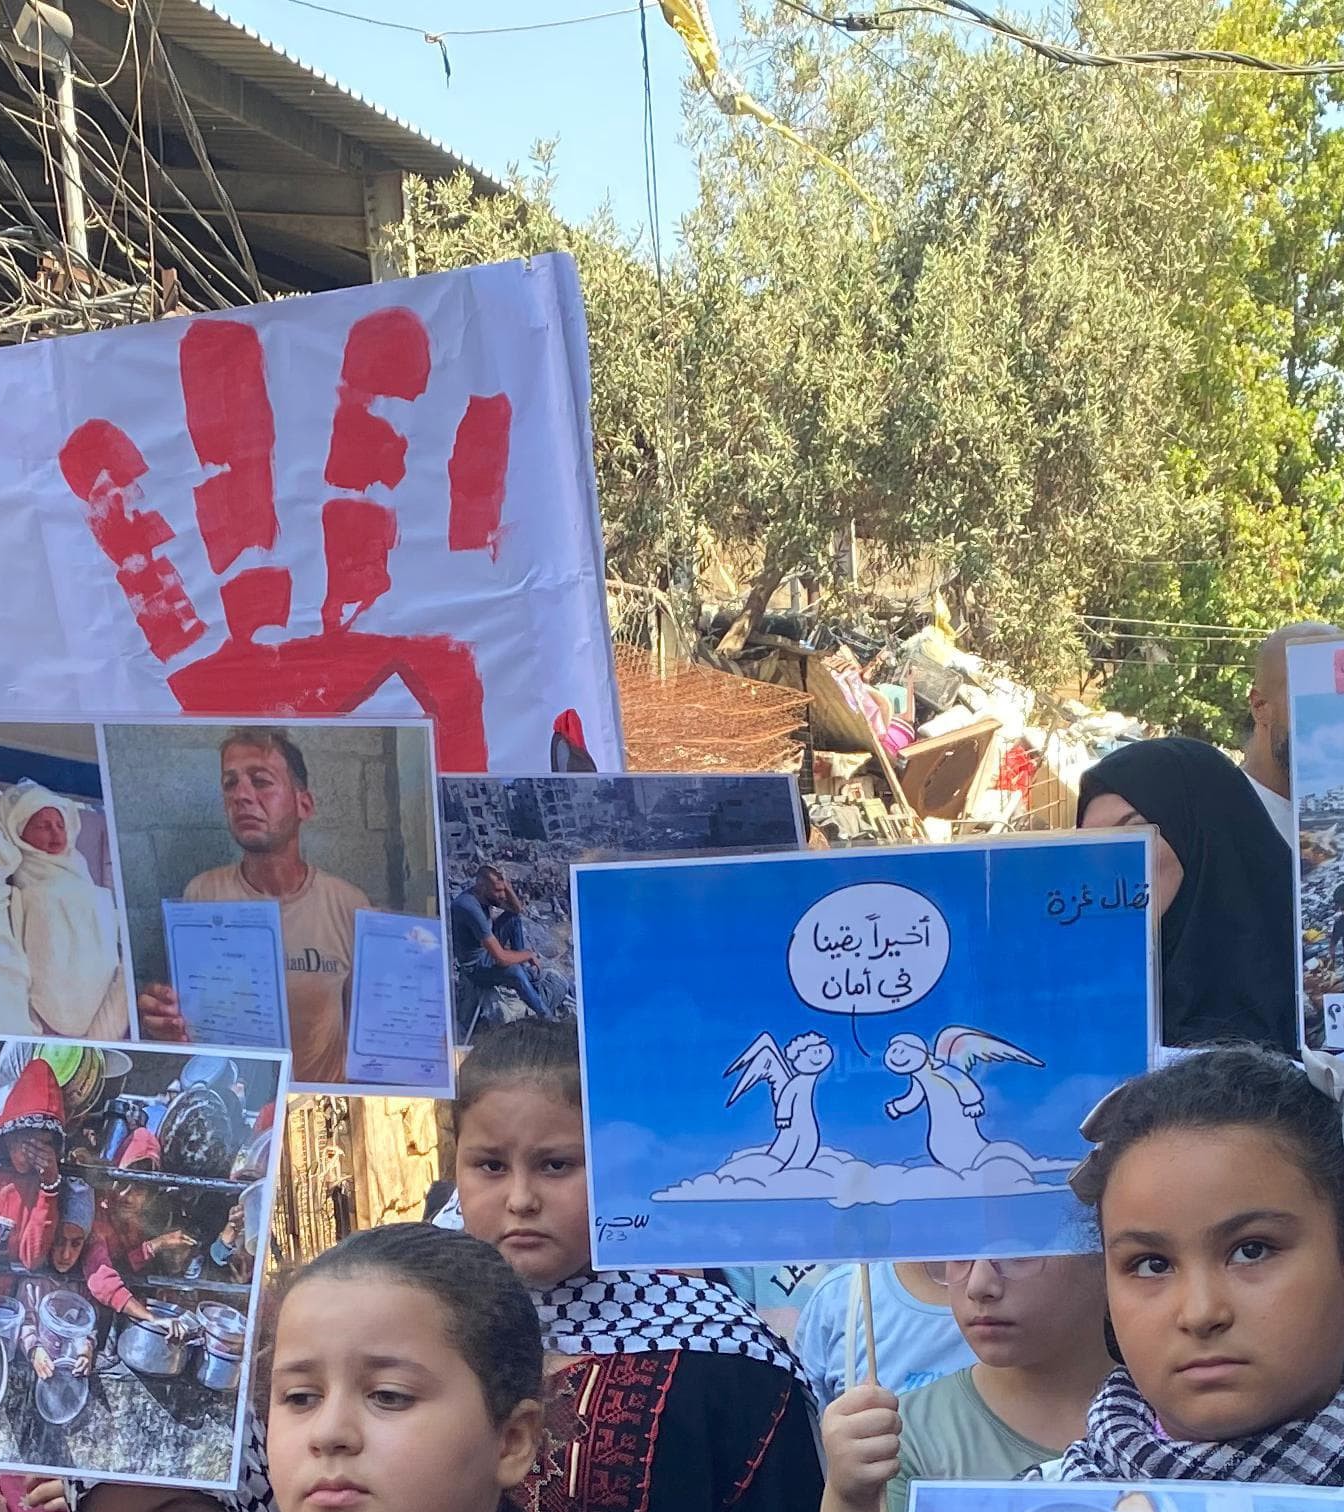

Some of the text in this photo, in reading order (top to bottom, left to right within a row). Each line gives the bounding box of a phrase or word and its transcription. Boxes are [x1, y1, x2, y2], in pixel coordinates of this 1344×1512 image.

[813, 922, 862, 960] بقينا
[822, 967, 913, 1003] في أمان
